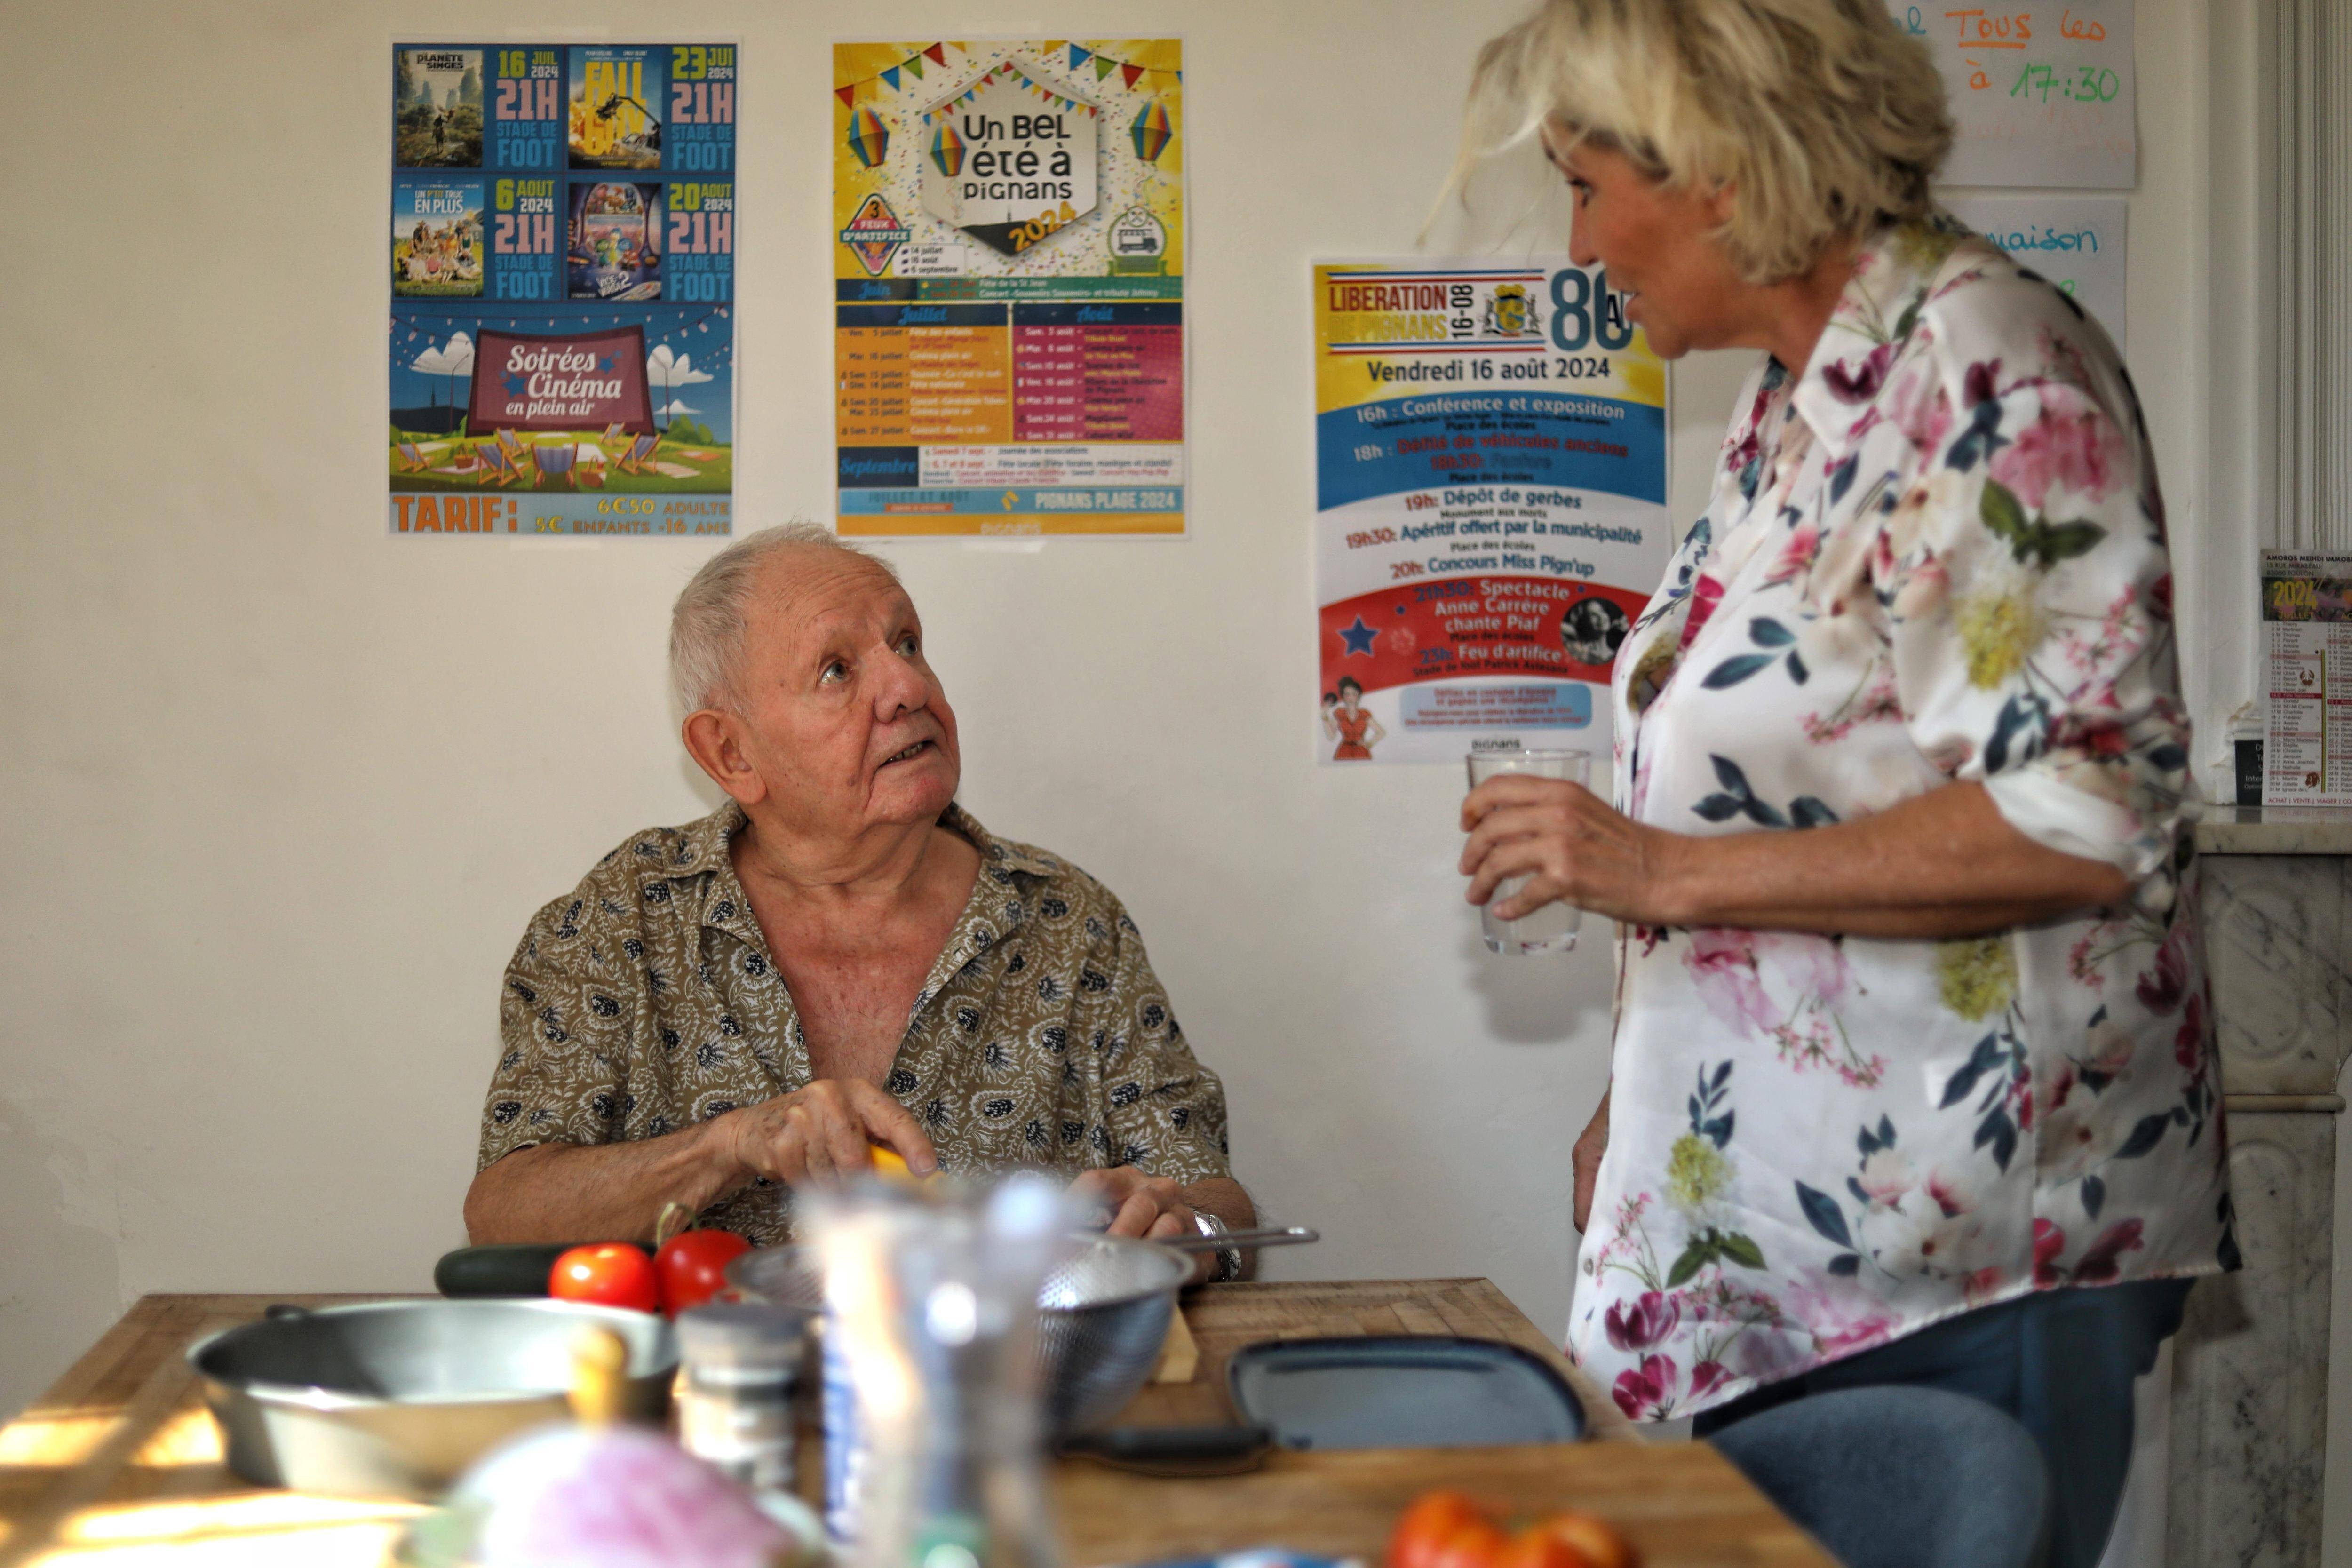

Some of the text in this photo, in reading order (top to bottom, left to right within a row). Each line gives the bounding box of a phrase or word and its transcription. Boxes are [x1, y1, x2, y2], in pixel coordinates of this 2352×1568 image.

[2060, 9, 2106, 41] les
[499, 50, 526, 78] 16
[532, 51, 558, 65] JUIL
[672, 46, 707, 80] 23
[531, 65, 559, 78] 2024
[708, 67, 734, 80] 2024
[1966, 59, 2120, 103] à 17:30
[585, 62, 646, 108] FALL
[496, 79, 558, 120] 21H
[671, 82, 734, 124] 21H
[497, 121, 557, 137] STADE DE
[672, 124, 732, 141] STADE DE
[963, 114, 1005, 141] Un
[497, 138, 557, 167] FOOT
[673, 142, 732, 171] FOOT
[972, 141, 1072, 177] été à
[415, 199, 464, 213] EN PLUS
[496, 178, 555, 210] 6 AOUT
[520, 198, 554, 213] 2024
[669, 183, 732, 211] 20 AOUT
[704, 199, 733, 211] 2024
[870, 200, 880, 218] 3
[495, 214, 555, 254] 21H
[669, 212, 732, 254] 21H
[1008, 200, 1077, 253] 2024
[539, 254, 554, 270] DE
[715, 255, 731, 271] DE
[496, 271, 553, 300] FOOT
[670, 272, 730, 302] FOOT
[1329, 284, 1447, 312] LIBERATION
[898, 305, 948, 326] Juillet
[1451, 284, 1474, 340] 16-08
[1359, 313, 1448, 341] PIGNANS
[506, 344, 596, 373] Soirées
[1367, 357, 1610, 382] Vendredi 16 août 2024
[527, 371, 623, 399] Cinéma
[505, 398, 596, 420] en plein air
[1401, 397, 1504, 417] Conférence
[1508, 397, 1527, 412] et
[1532, 398, 1625, 420] exposition
[1397, 435, 1448, 454] Défilé
[1453, 433, 1474, 448] de
[1480, 432, 1559, 449] véhicules
[1565, 437, 1629, 458] anciens
[840, 456, 919, 479] Septembre
[597, 497, 730, 516] 6€50 ADULTE
[1035, 492, 1176, 509] PIGNANS PLAGE 2024
[1444, 488, 1495, 507] Dépôt
[1499, 487, 1520, 503] de
[1526, 489, 1582, 509] gerbes
[535, 516, 564, 533] 5€
[573, 521, 651, 534] ENFANTS
[695, 523, 730, 534] ANS
[1440, 508, 1495, 519] Monument
[1400, 519, 1456, 543] Apéritif
[1459, 519, 1501, 535] offert
[1504, 521, 1529, 537] par
[1532, 518, 1547, 535] la
[1550, 521, 1643, 546] municipalité
[1428, 556, 1498, 573] Concours
[1502, 553, 1535, 570] Miss
[1479, 578, 1570, 601] Spectacle
[2273, 581, 2319, 610] 2024
[1434, 597, 1550, 617] Anne Carrère
[1444, 614, 1541, 633] chante Piaf
[1458, 643, 1488, 660] Feu
[1492, 642, 1562, 663] d'artifice
